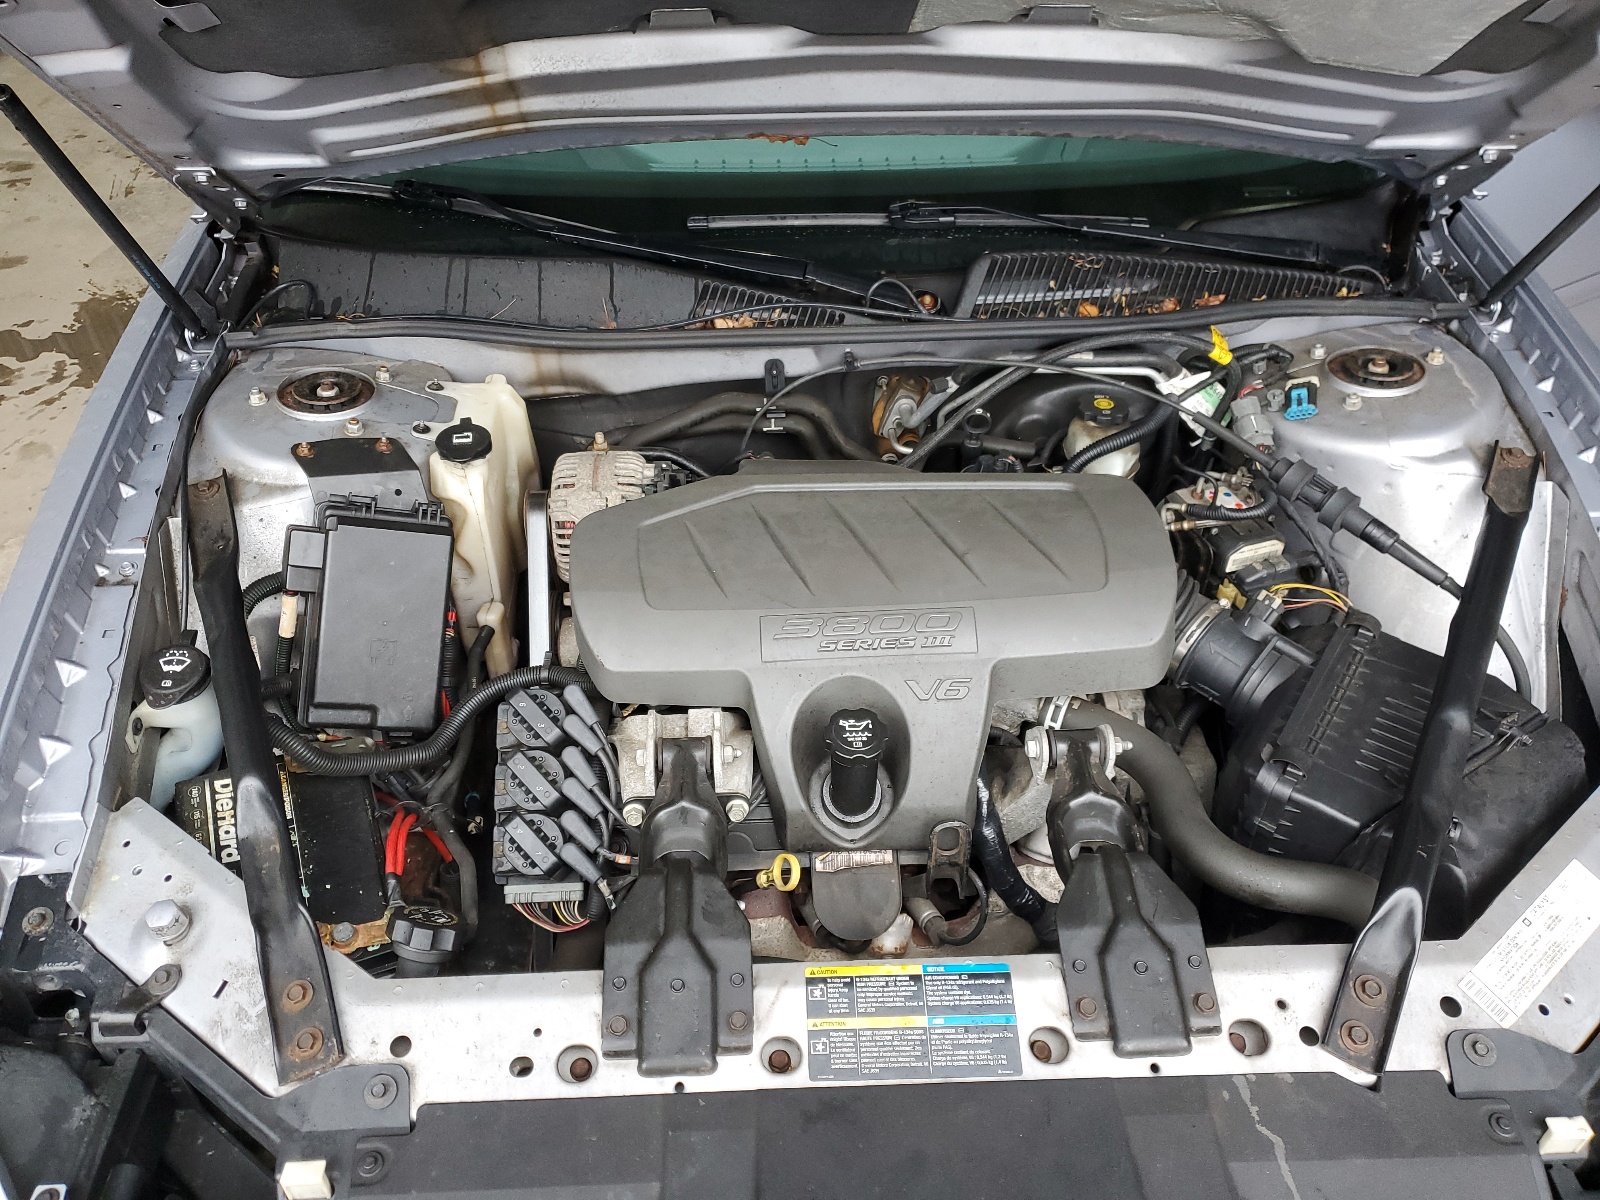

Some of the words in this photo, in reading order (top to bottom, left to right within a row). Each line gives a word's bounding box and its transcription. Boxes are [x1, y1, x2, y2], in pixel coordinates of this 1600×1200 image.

[773, 611, 962, 640] 3800
[817, 636, 917, 652] SERIES
[921, 635, 955, 647] III
[904, 678, 972, 701] V6
[213, 778, 241, 864] DieHard
